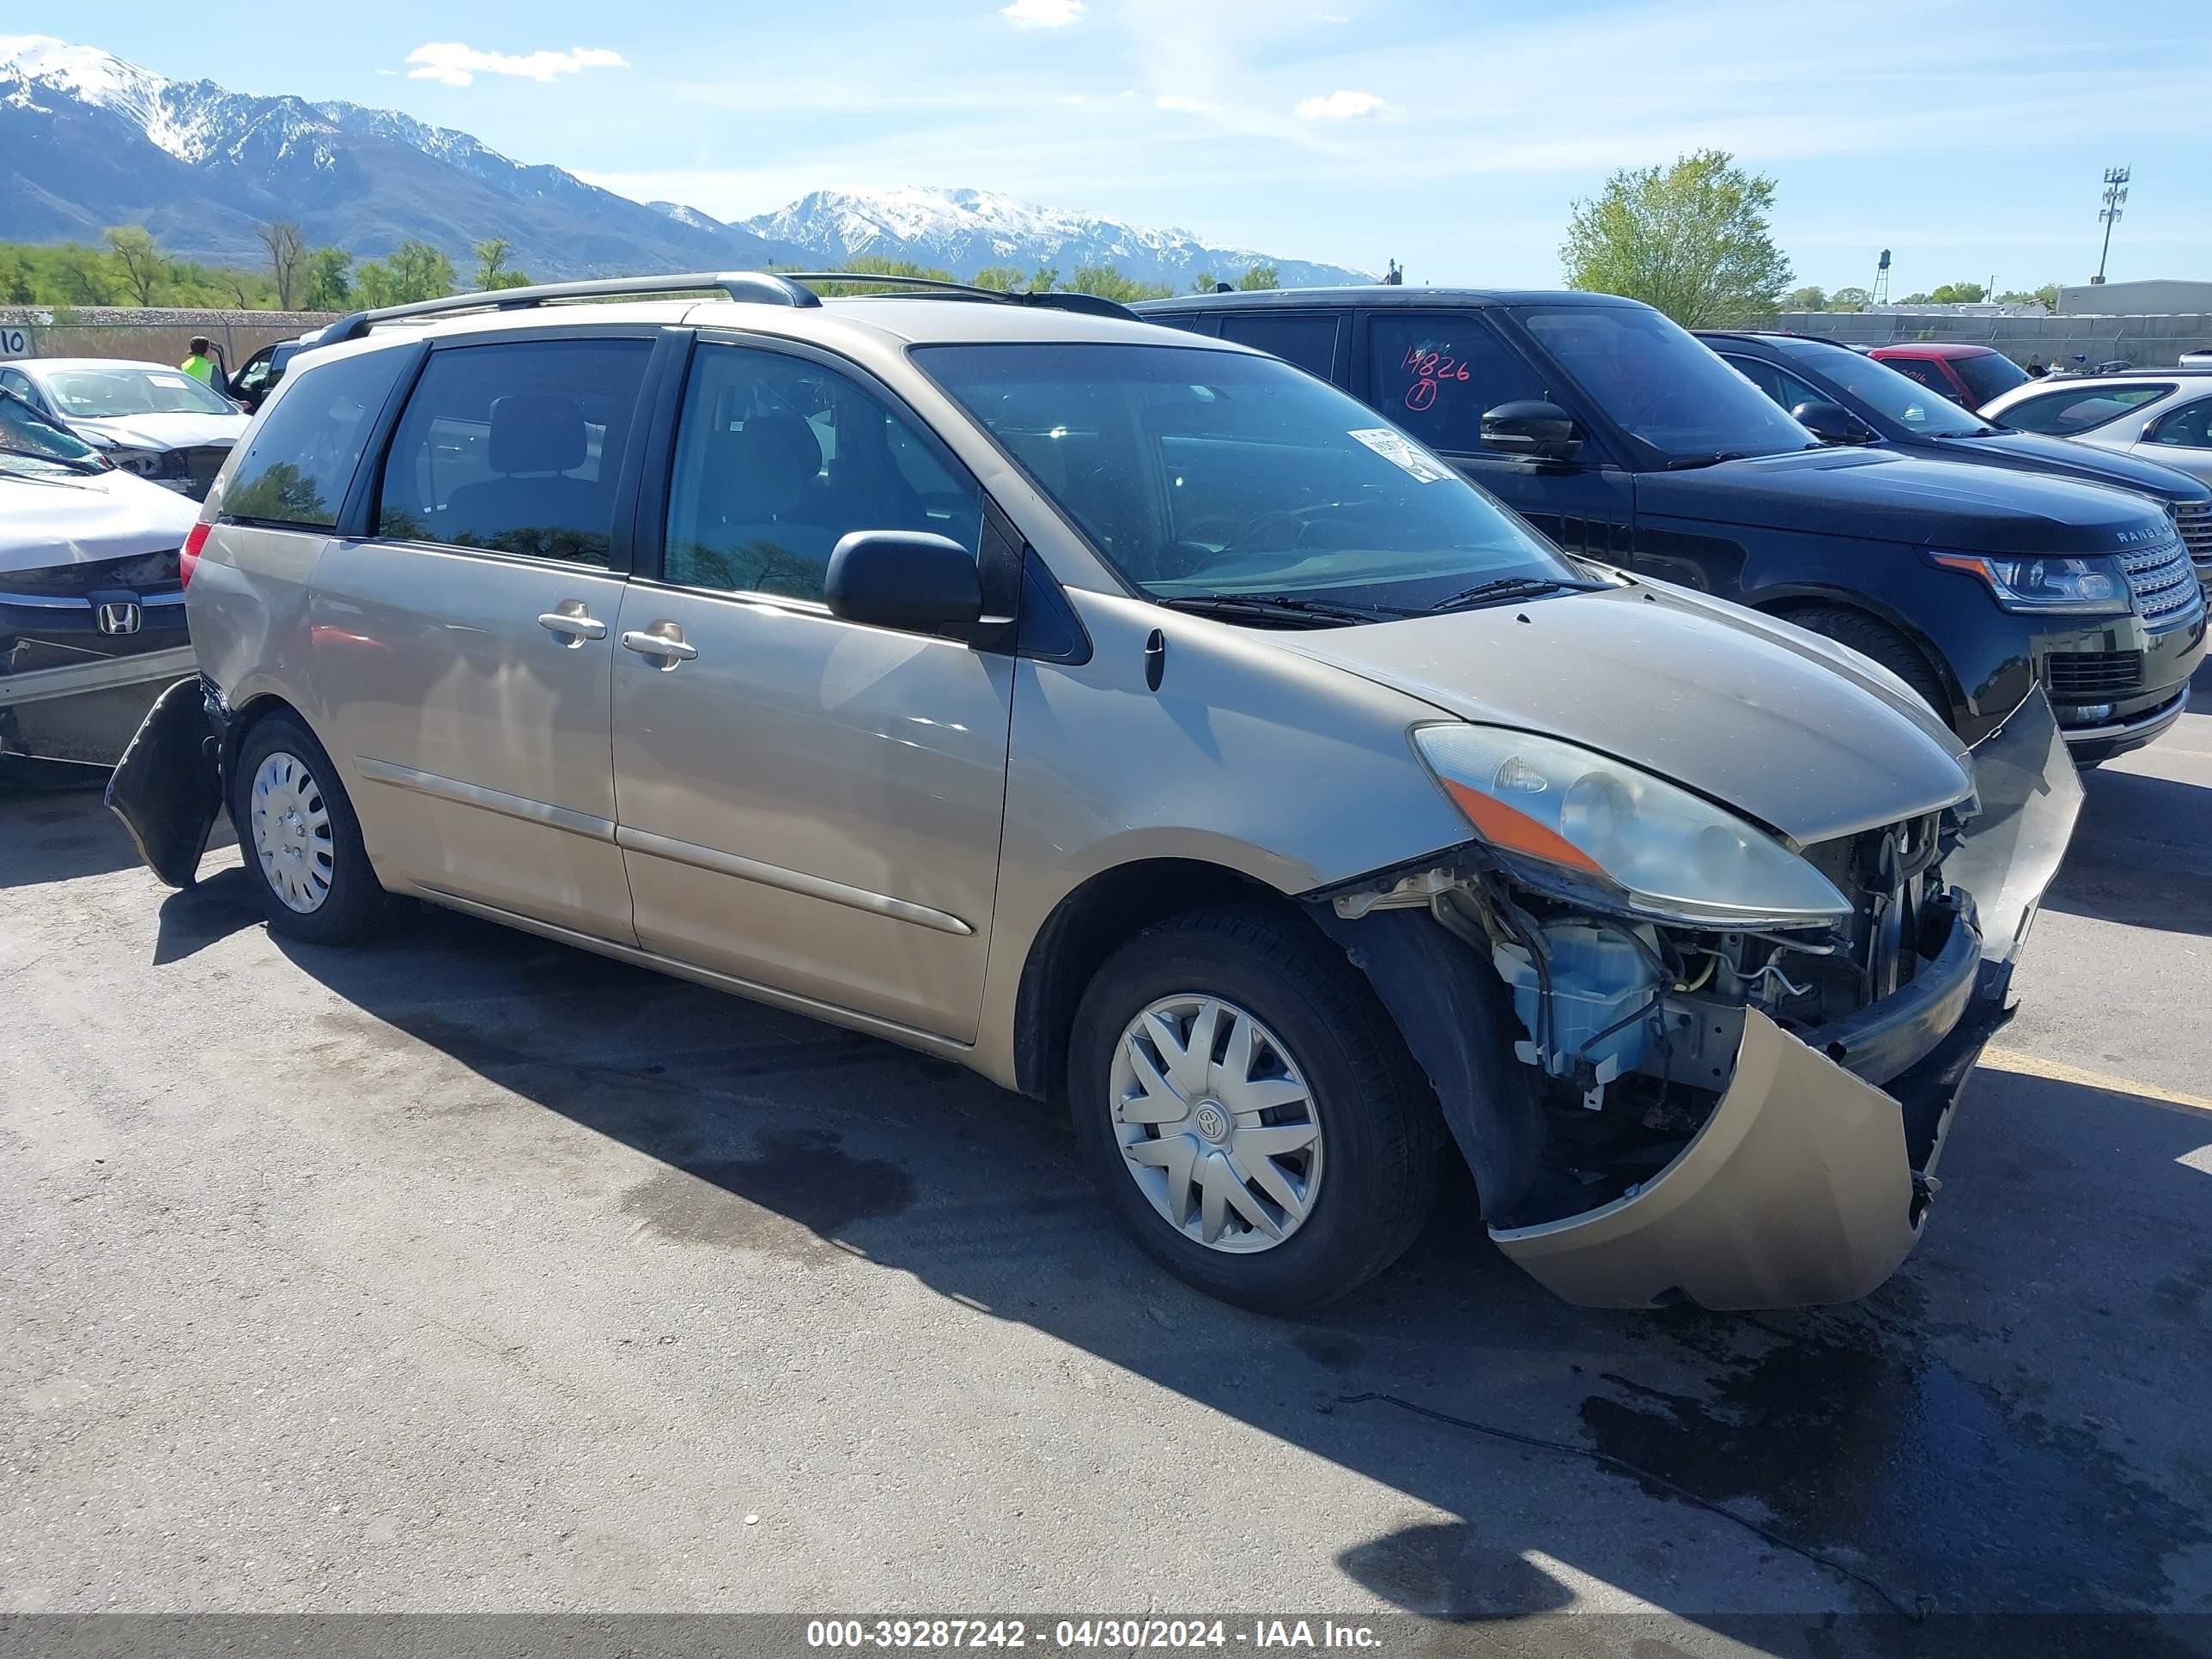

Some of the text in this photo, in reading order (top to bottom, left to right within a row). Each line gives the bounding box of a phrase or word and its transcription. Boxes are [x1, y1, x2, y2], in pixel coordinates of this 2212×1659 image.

[1, 330, 24, 354] 10
[1400, 345, 1471, 381] 14826
[2116, 528, 2161, 543] RANGE
